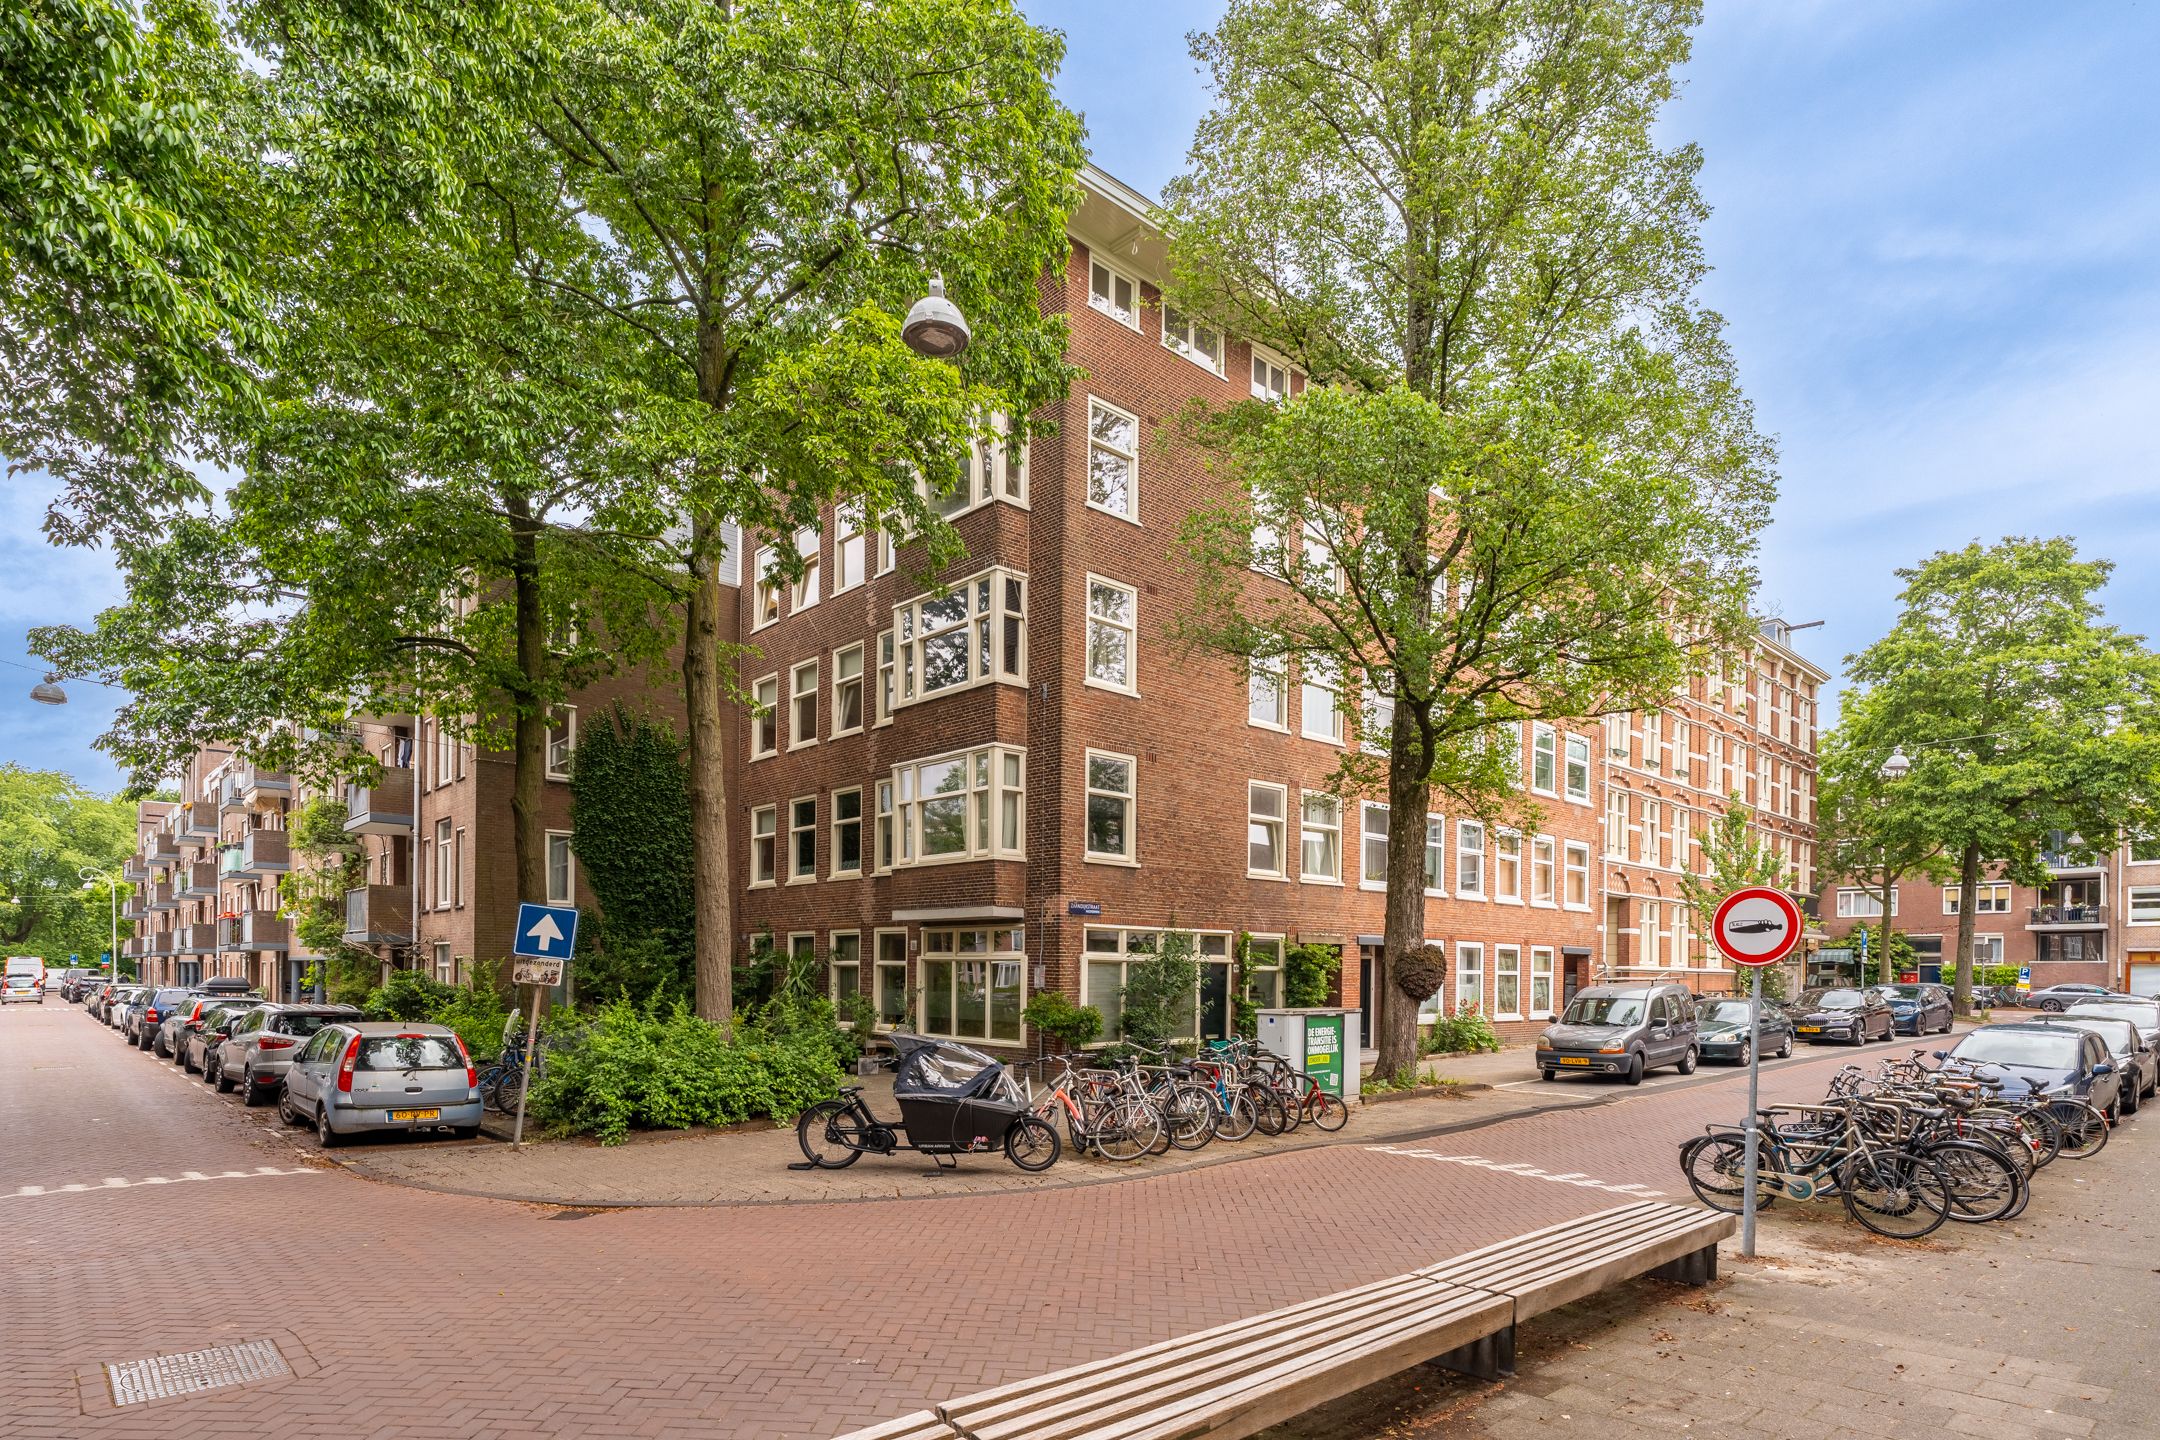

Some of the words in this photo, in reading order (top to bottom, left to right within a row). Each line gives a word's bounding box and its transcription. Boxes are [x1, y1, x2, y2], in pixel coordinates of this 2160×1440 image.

[1308, 1028, 1314, 1037] DE
[1315, 1026, 1336, 1036] ENERGIE-
[1308, 1044, 1339, 1055] ONMOGELIJK
